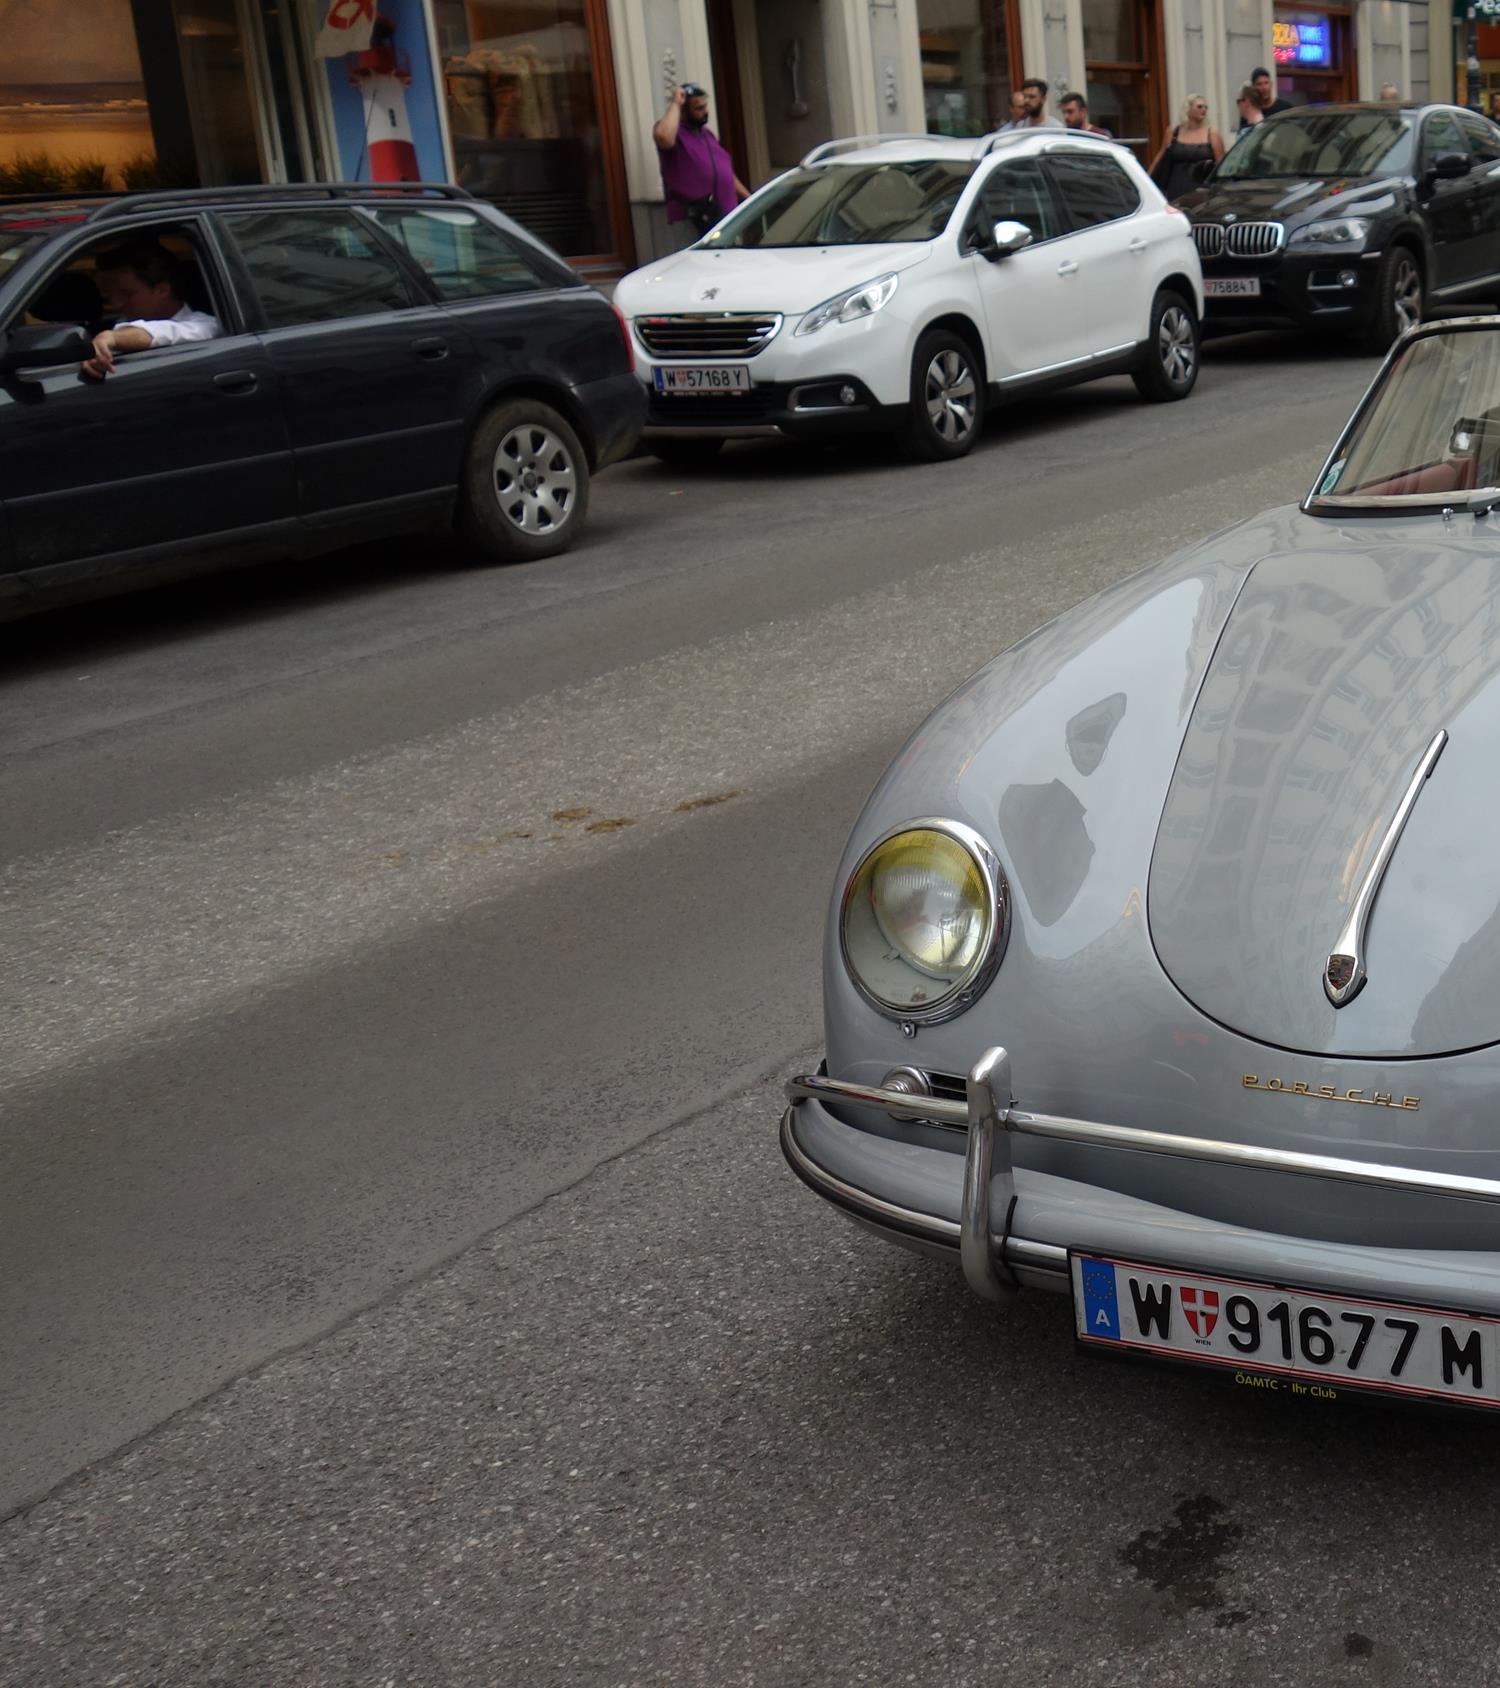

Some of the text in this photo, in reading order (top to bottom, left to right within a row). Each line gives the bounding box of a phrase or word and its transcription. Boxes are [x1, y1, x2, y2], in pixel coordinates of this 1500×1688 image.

[1249, 281, 1255, 292] T
[664, 370, 741, 387] W 57168 Y
[1242, 1074, 1420, 1111] PORSCHE
[1096, 1278, 1483, 1389] A W 91677 M
[1194, 1338, 1212, 1346] WIEN
[1235, 1371, 1279, 1390] ÖAMTC
[1292, 1383, 1307, 1394] Ihr
[1310, 1386, 1337, 1399] Club
